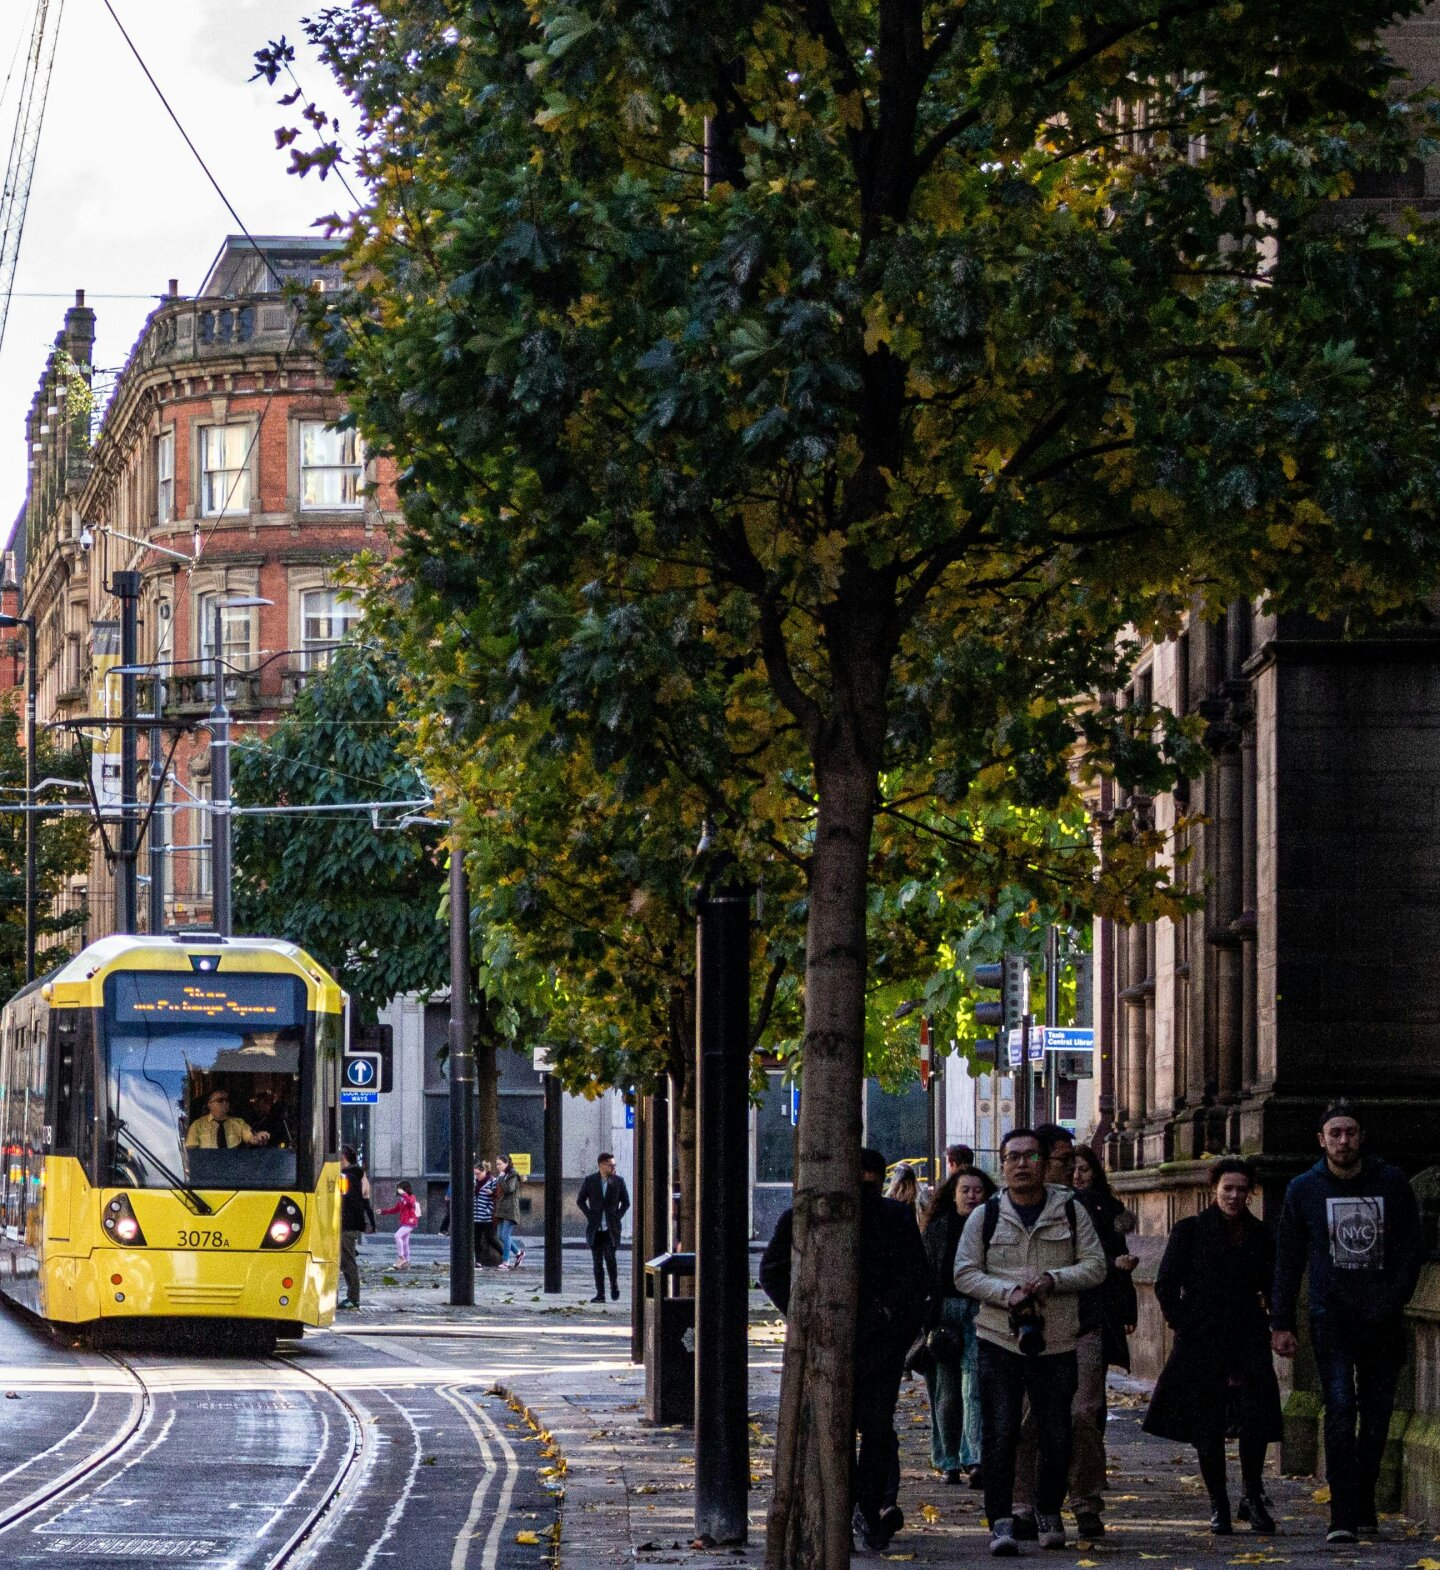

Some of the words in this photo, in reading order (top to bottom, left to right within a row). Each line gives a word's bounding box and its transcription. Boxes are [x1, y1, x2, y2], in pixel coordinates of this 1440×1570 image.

[1047, 1038, 1073, 1046] Central
[1074, 1038, 1095, 1046] Librar
[1342, 1225, 1372, 1240] NYC
